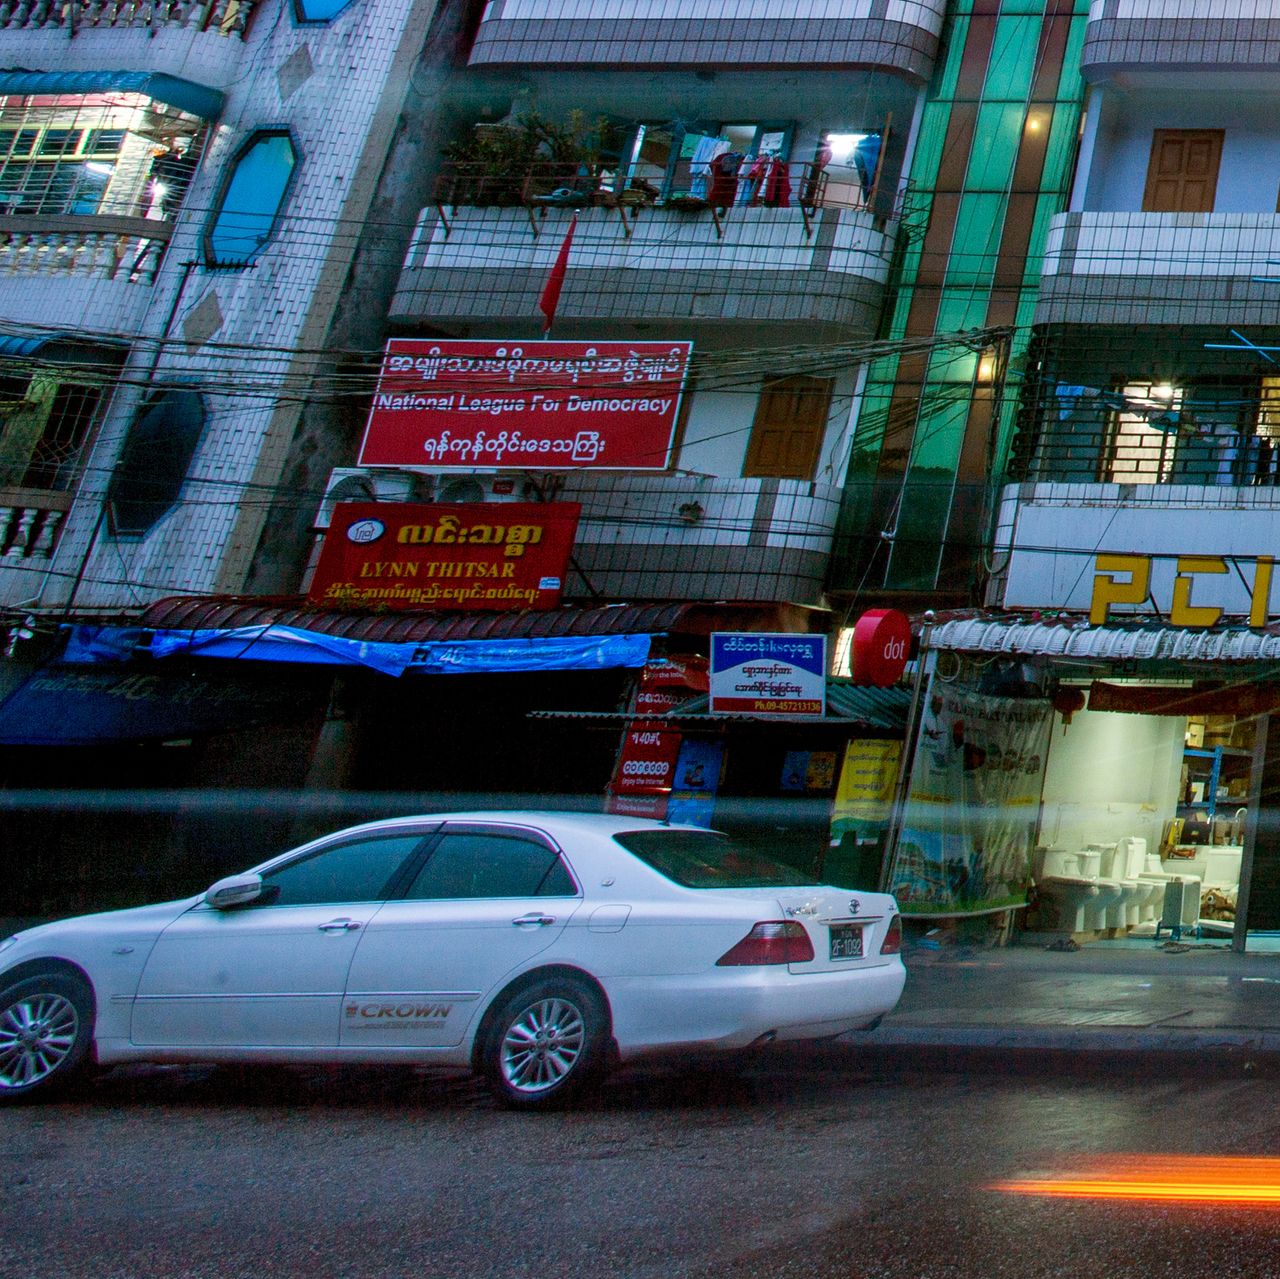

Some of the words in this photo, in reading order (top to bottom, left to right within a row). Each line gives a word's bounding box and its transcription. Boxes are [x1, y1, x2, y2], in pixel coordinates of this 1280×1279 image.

[377, 394, 455, 411] National
[458, 394, 526, 415] League
[530, 395, 562, 412] For
[566, 395, 672, 415] Democracy
[359, 562, 421, 578] LYNN
[426, 562, 516, 578] THITSAR
[1090, 554, 1275, 628] PCI
[883, 635, 906, 661] dot
[622, 760, 670, 775] ooredoo
[832, 938, 863, 956] 2F-1092
[360, 1002, 453, 1018] CROWN
